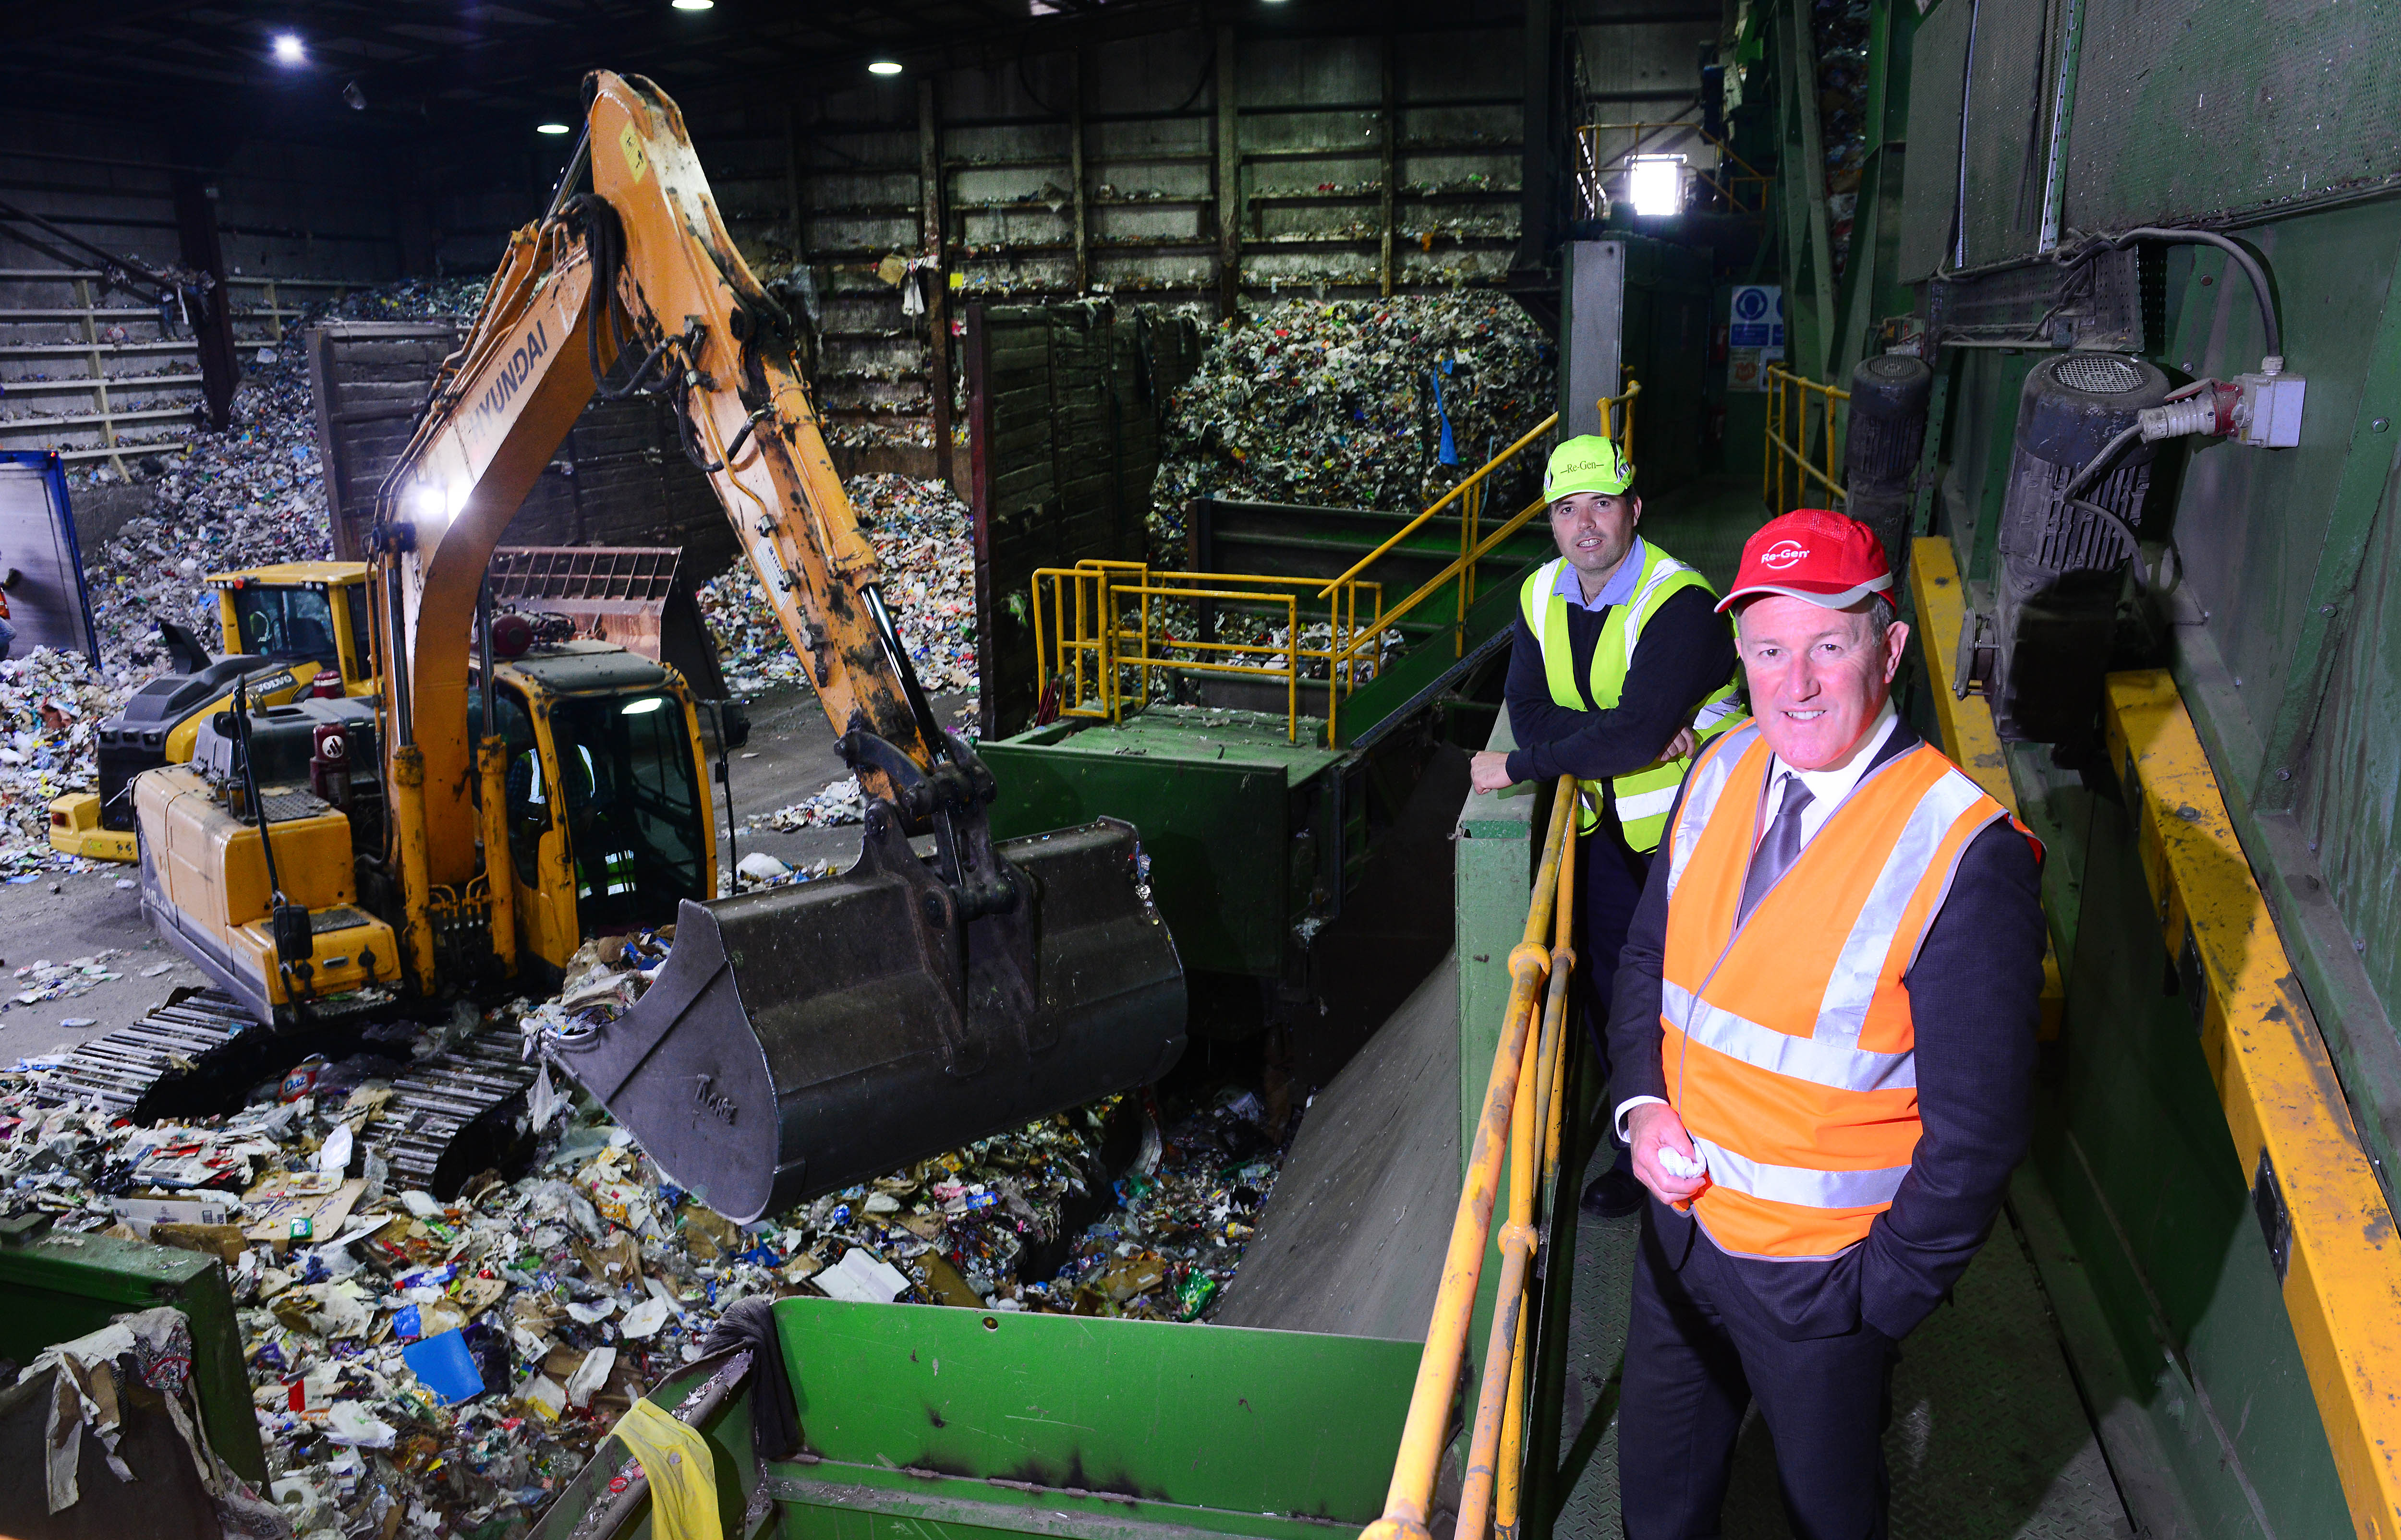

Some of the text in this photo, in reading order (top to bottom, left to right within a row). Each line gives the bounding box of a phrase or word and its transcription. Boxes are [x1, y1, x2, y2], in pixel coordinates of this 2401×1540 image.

[469, 319, 548, 439] HYUNDAI
[1567, 460, 1596, 473] Re-Gen
[1761, 549, 1807, 564] Re-Gen
